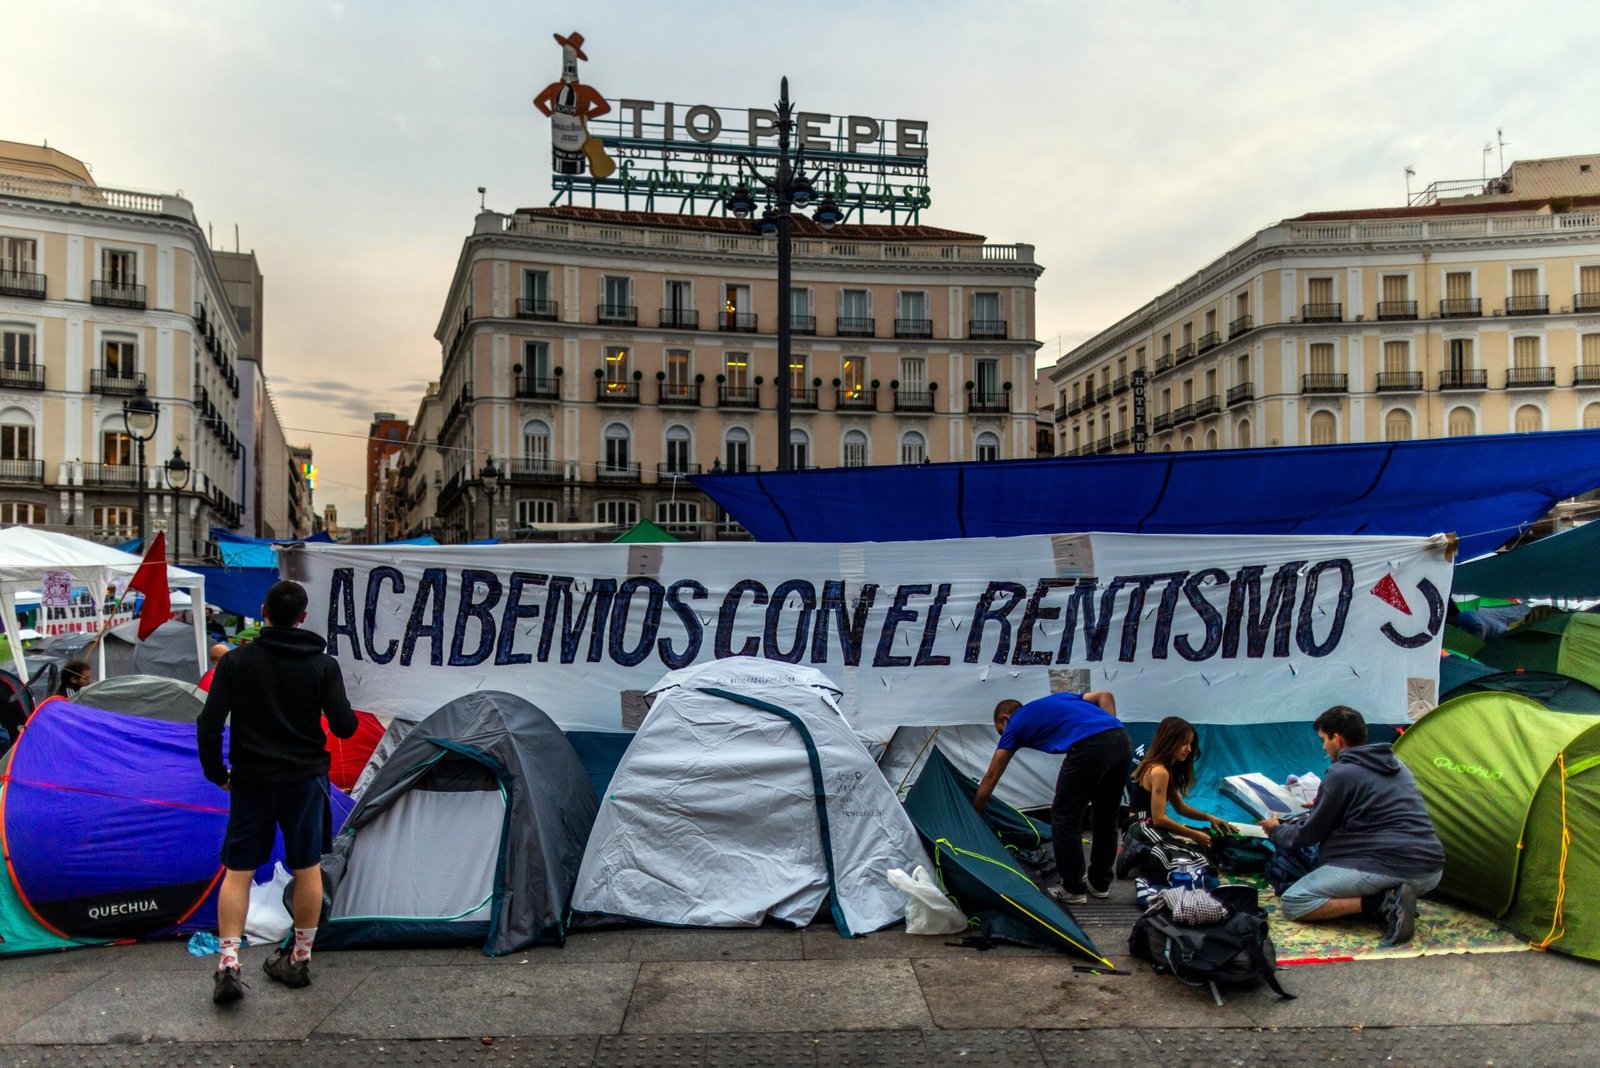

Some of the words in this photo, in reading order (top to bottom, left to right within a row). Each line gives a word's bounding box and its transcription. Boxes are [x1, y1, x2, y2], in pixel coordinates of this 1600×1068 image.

[620, 98, 723, 144] TIO
[748, 108, 929, 158] PEPE
[1135, 377, 1144, 426] HOTEL
[326, 565, 709, 670] ACABEMOS
[714, 579, 880, 666] CON
[872, 584, 952, 668] EL
[963, 558, 1355, 666] RENTISMO
[1434, 756, 1503, 780] Quechua
[88, 899, 159, 920] QUECHUA
